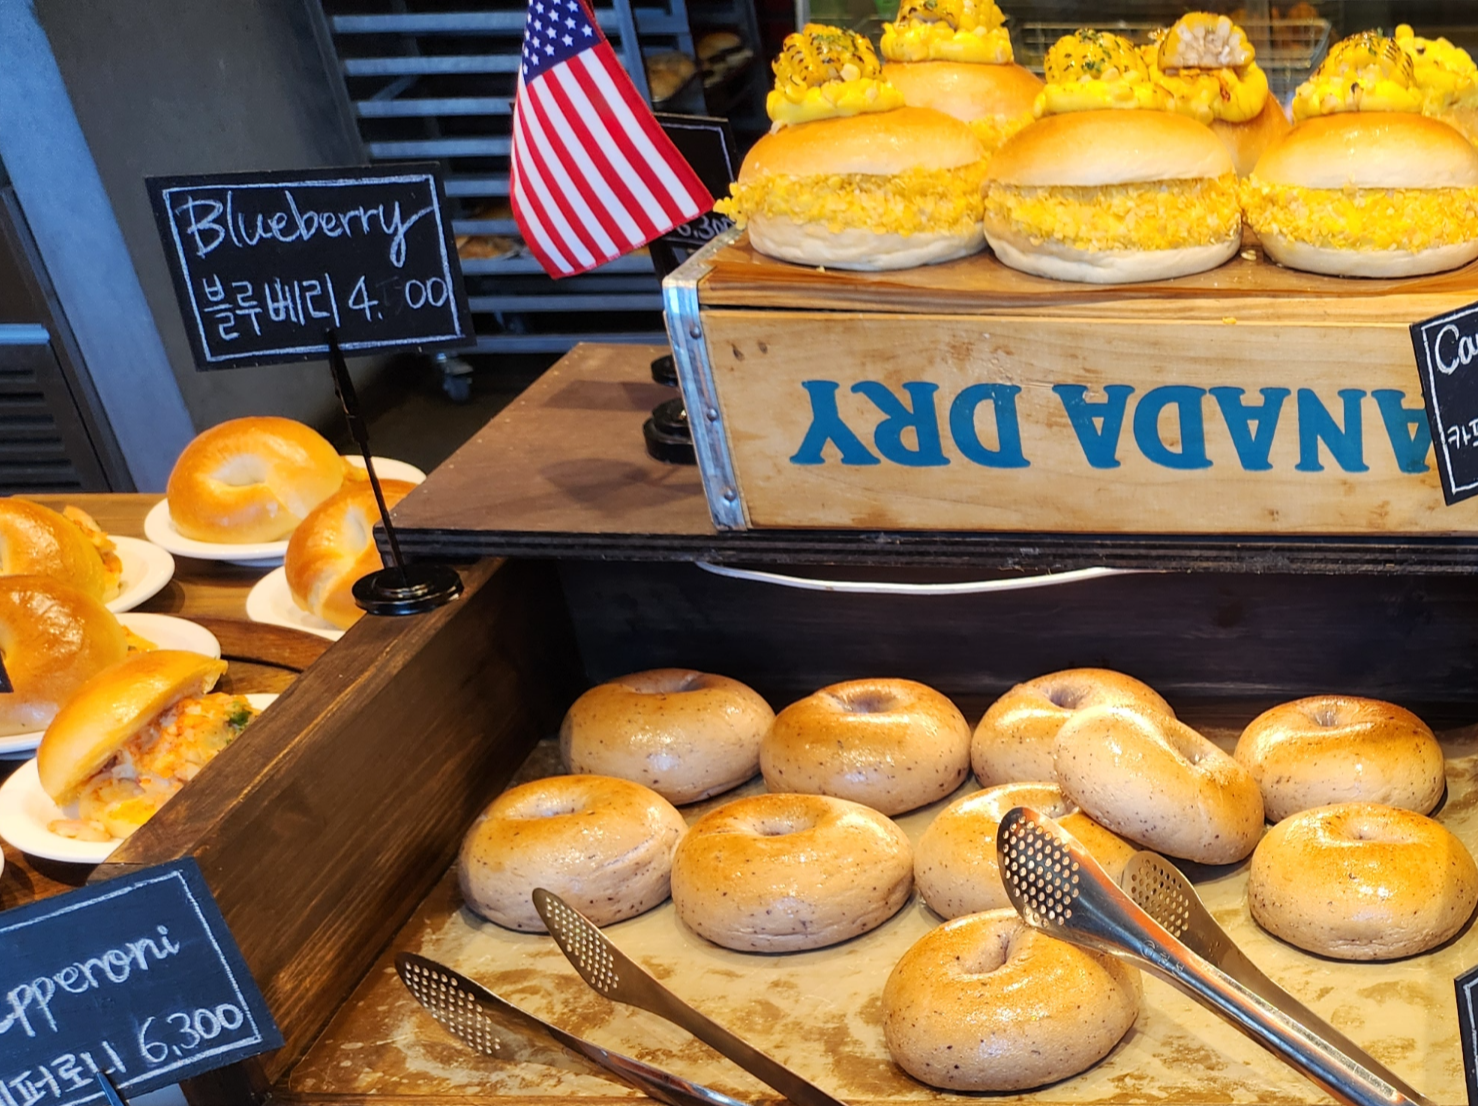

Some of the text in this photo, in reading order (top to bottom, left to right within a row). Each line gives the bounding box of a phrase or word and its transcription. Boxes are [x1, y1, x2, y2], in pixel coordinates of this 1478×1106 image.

[175, 190, 436, 268] Blueberry
[202, 272, 341, 341] 블루베리
[789, 379, 1432, 473] ANADA DRY
[0, 925, 180, 1037] pperoni
[138, 1003, 245, 1063] 6,300
